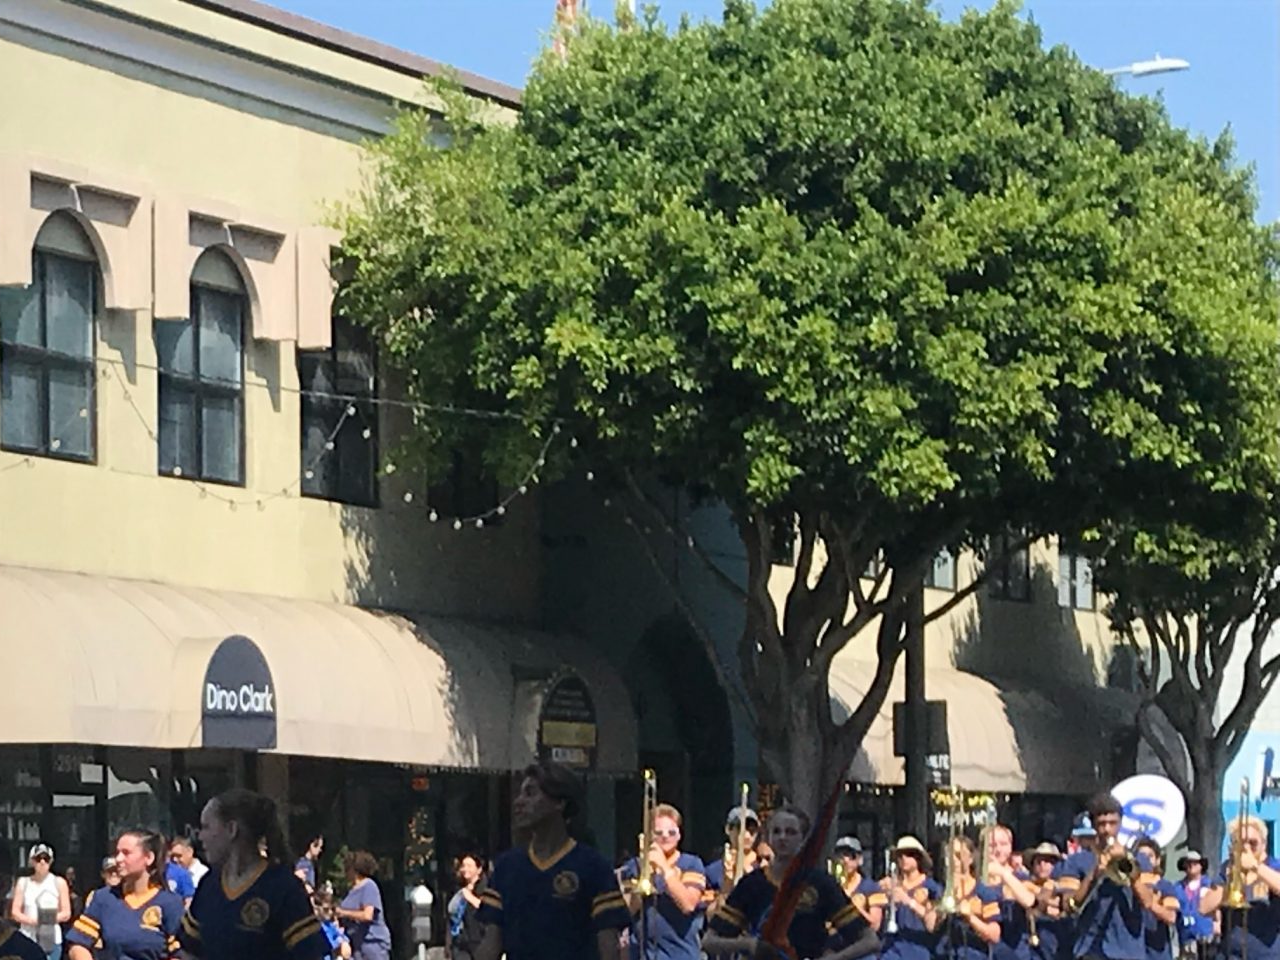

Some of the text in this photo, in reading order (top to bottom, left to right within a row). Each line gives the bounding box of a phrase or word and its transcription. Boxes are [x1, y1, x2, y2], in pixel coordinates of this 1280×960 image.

[206, 682, 273, 713] Dino Clark
[1118, 798, 1166, 837] S
